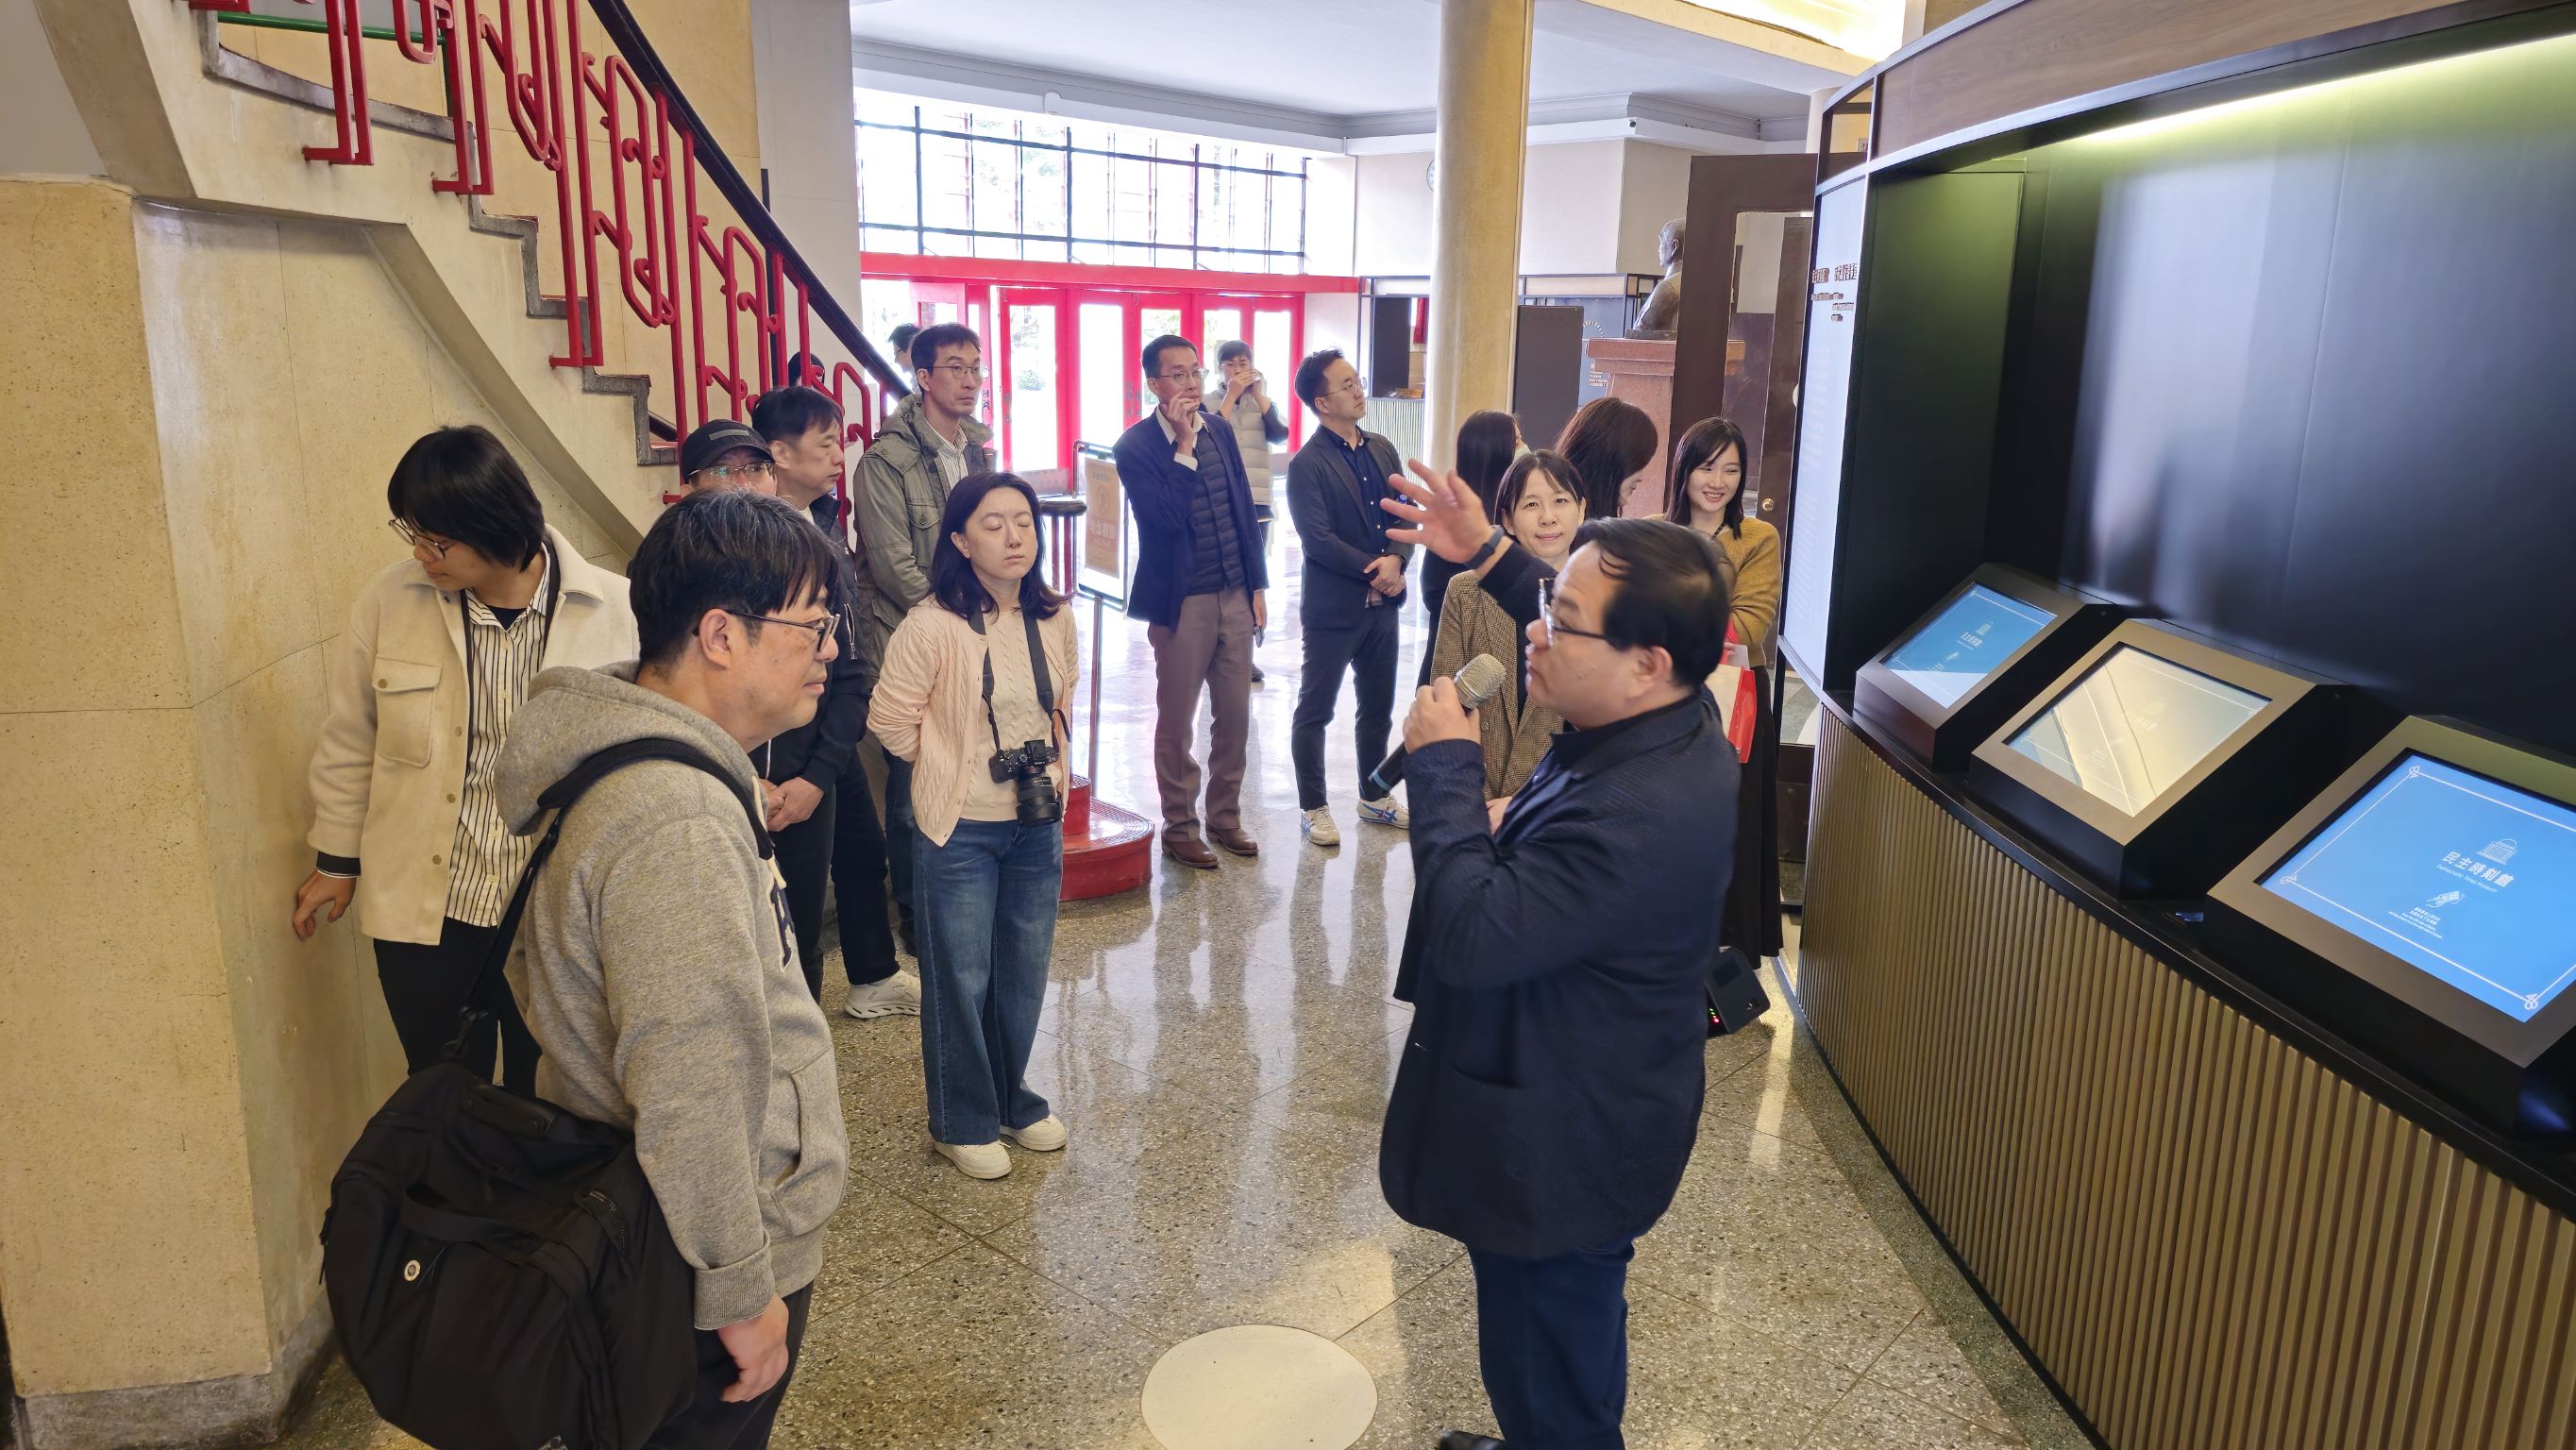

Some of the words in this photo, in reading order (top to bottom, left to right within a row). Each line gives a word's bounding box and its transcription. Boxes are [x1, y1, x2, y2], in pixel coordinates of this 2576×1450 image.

[2442, 851, 2515, 887] 民主時刻館
